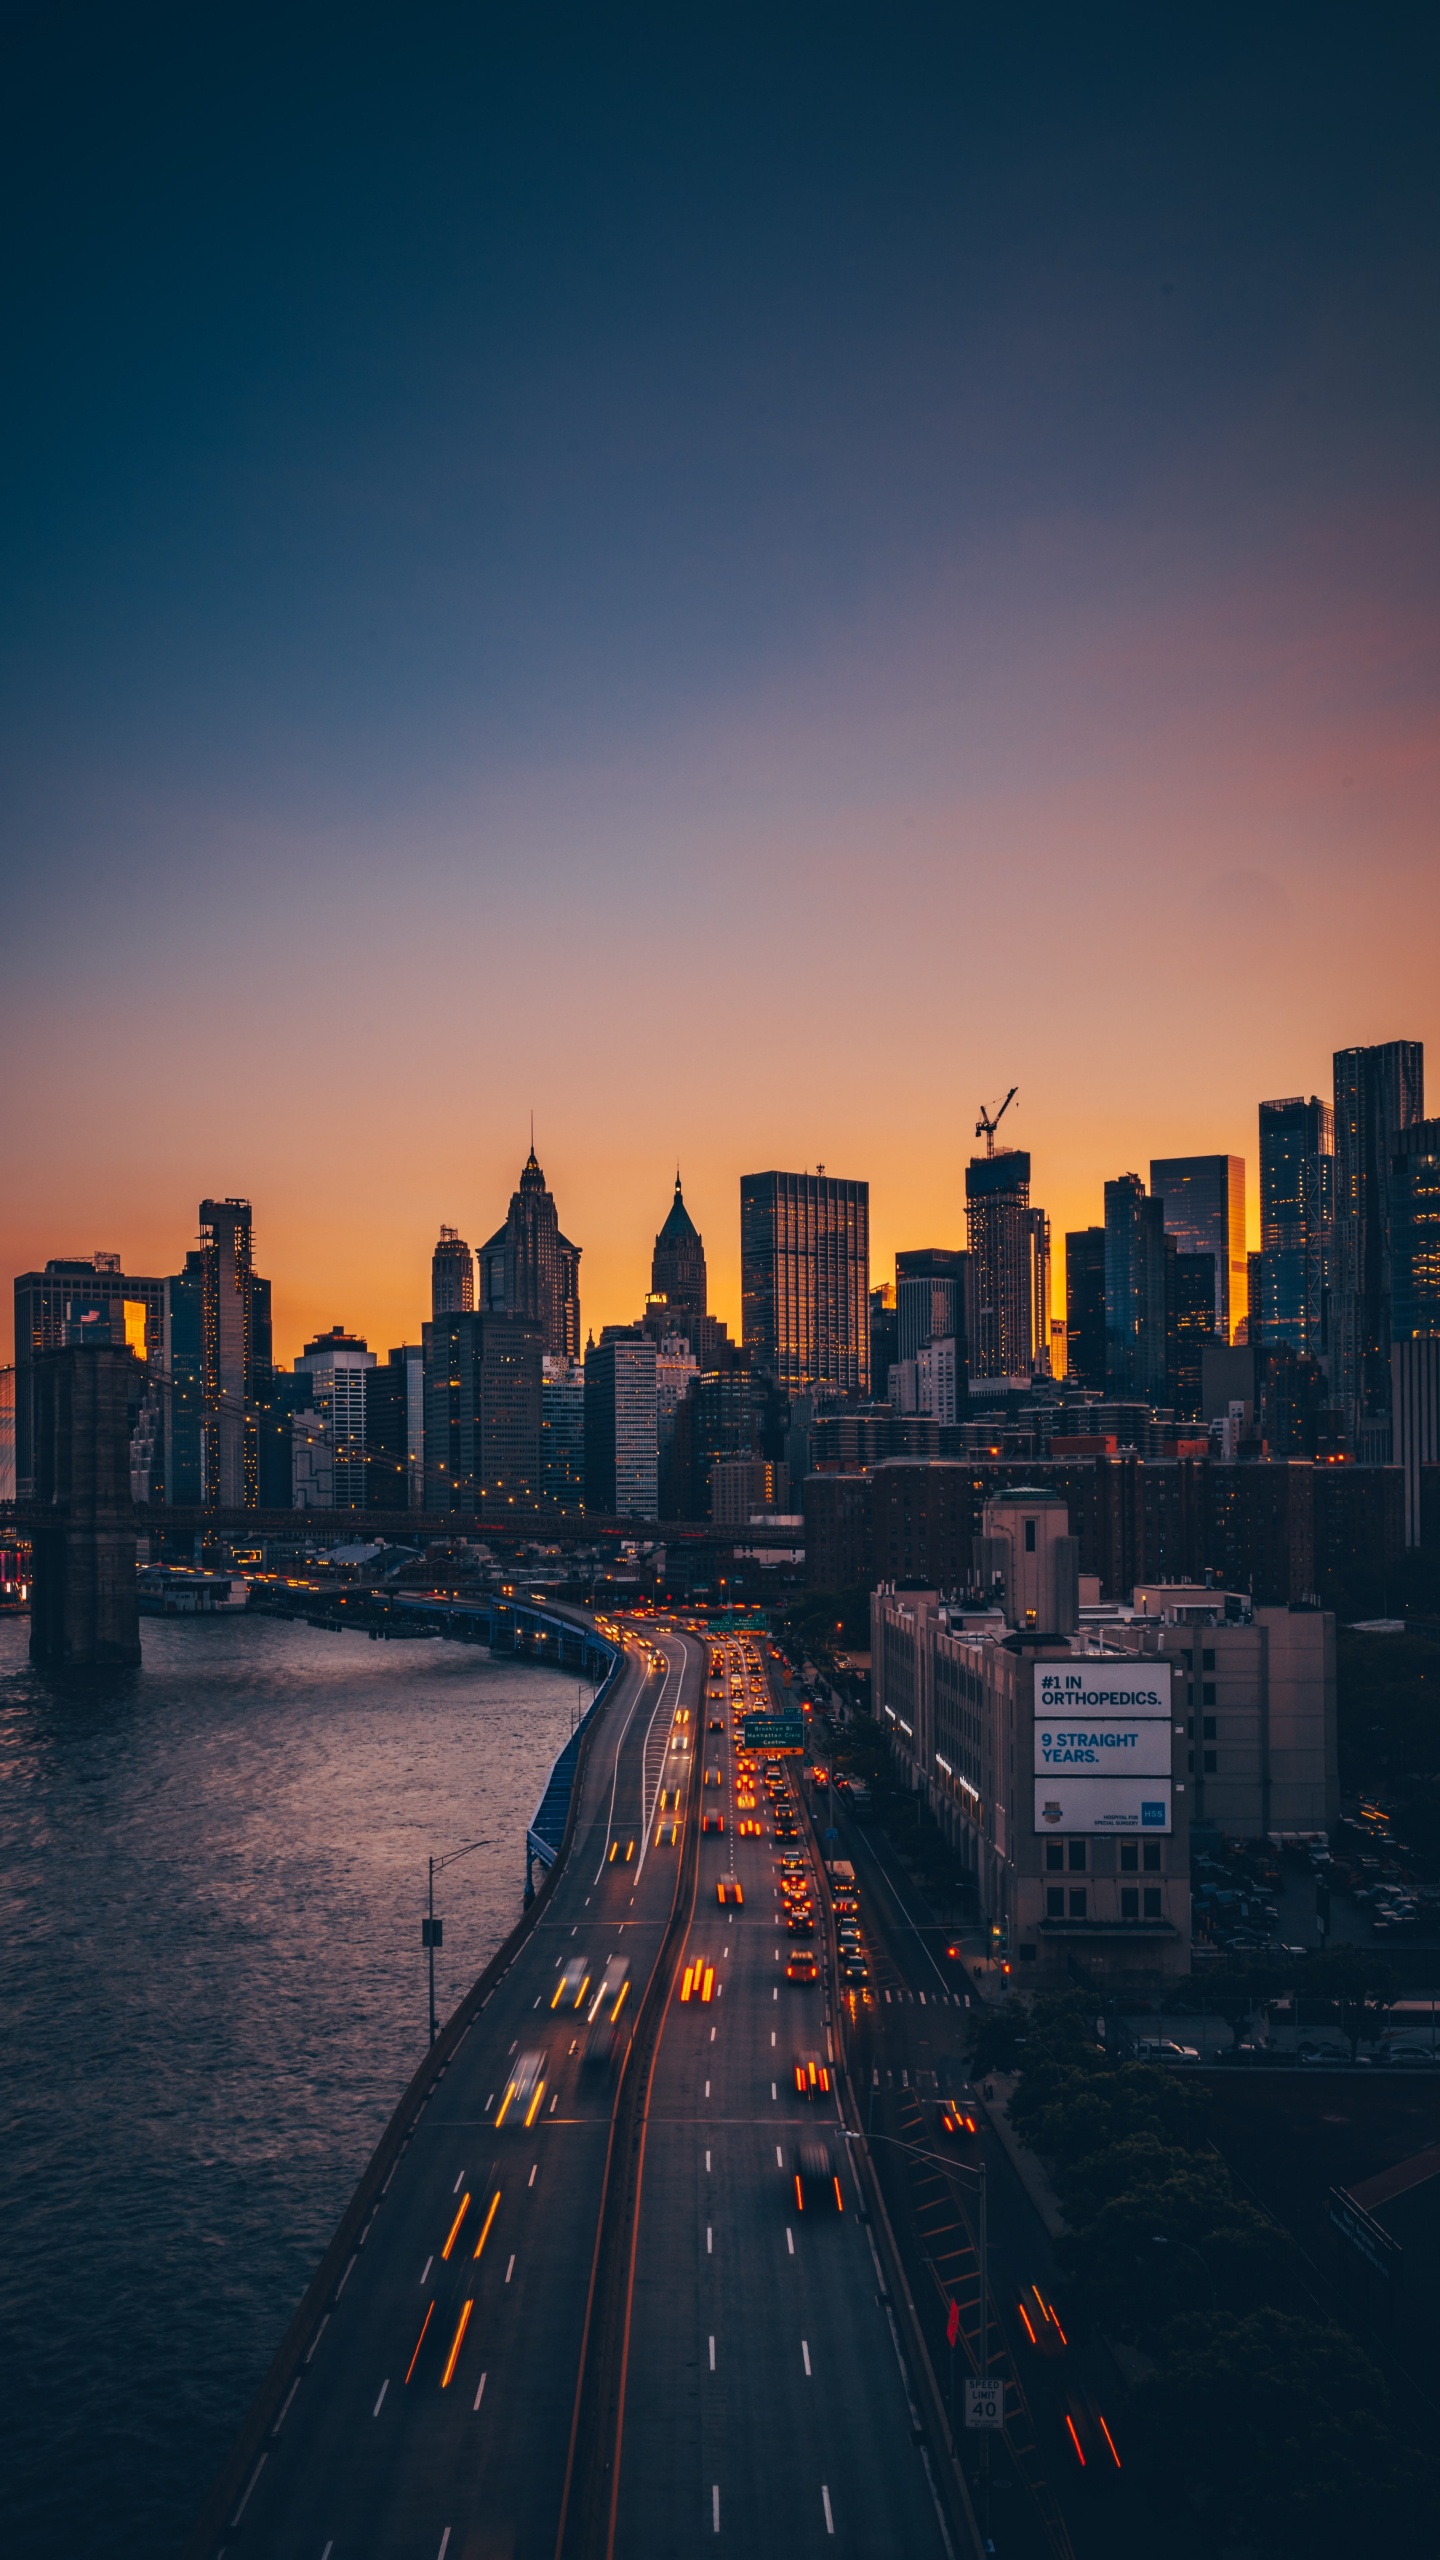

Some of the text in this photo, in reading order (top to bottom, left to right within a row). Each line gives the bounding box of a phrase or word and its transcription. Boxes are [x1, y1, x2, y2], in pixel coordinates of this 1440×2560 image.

[1041, 1676, 1082, 1689] #1 IN
[1041, 1691, 1162, 1705] ORTHOPEDICS.
[1041, 1733, 1138, 1747] 9 STRAIGHT
[1041, 1749, 1100, 1763] YEARS.
[1144, 1810, 1163, 1818] HSS
[969, 2380, 999, 2389] SPEED
[972, 2391, 995, 2399] LIMIT
[972, 2402, 996, 2417] 40
